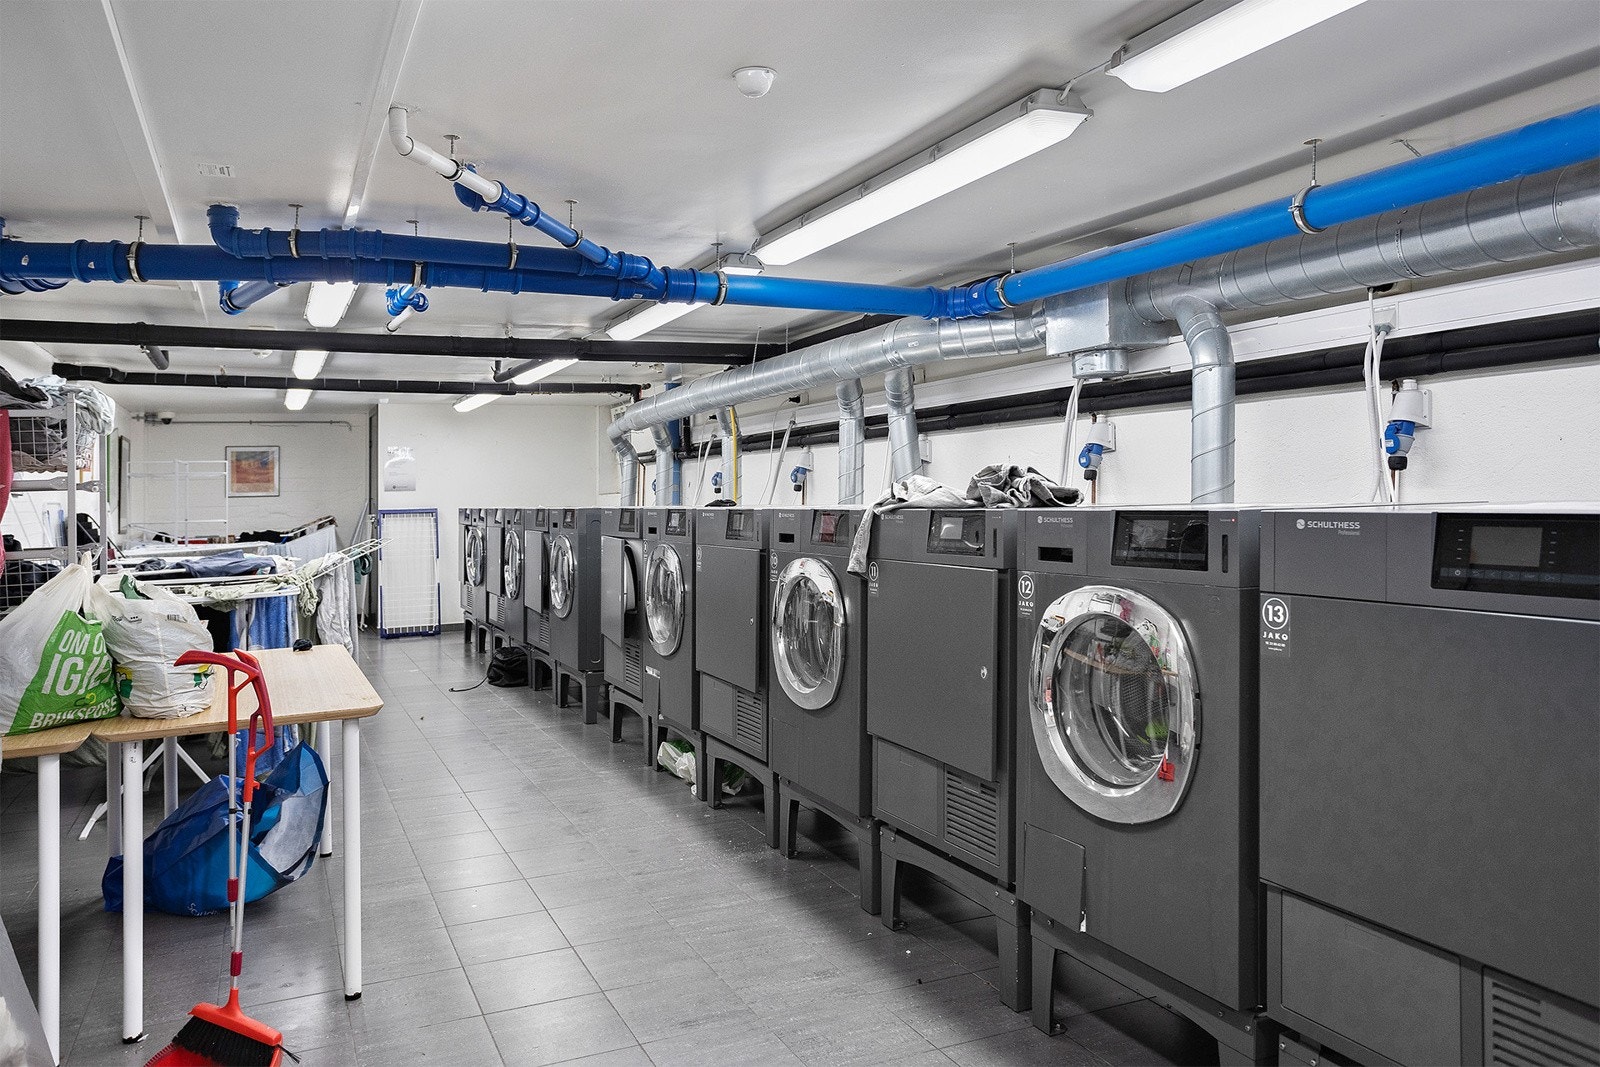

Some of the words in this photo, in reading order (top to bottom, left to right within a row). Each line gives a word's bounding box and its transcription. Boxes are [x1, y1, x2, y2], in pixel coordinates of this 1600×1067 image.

[1307, 521, 1360, 529] SCHULTHESS
[1021, 581, 1032, 593] 12
[1267, 605, 1284, 623] 13
[58, 629, 91, 655] OM
[92, 632, 107, 655] O
[1262, 631, 1289, 641] JAKO
[29, 694, 118, 729] BRUKSPOSE
